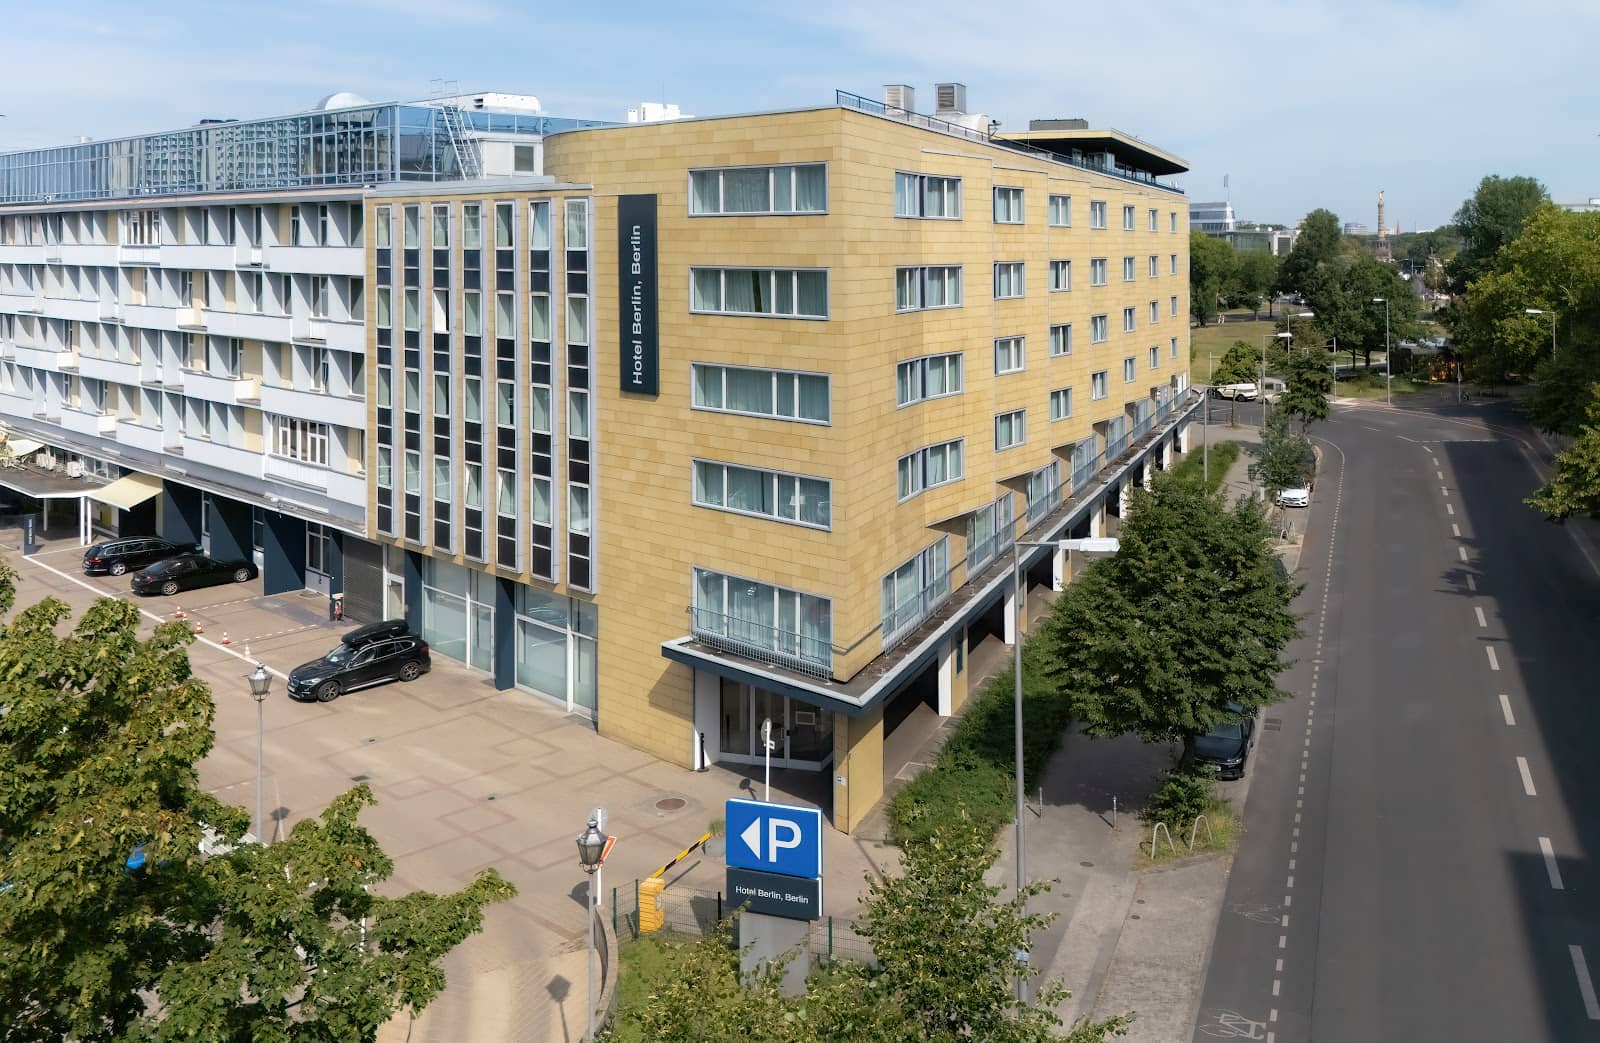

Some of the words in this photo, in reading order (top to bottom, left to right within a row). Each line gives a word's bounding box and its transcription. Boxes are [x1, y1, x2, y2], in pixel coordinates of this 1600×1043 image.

[630, 224, 641, 275] Berlin
[631, 280, 642, 335] Berlin,
[632, 340, 643, 385] Hotel
[768, 817, 802, 863] P
[735, 885, 757, 896] Hotel
[758, 888, 783, 901] Berlin,
[785, 893, 809, 904] Berlin
